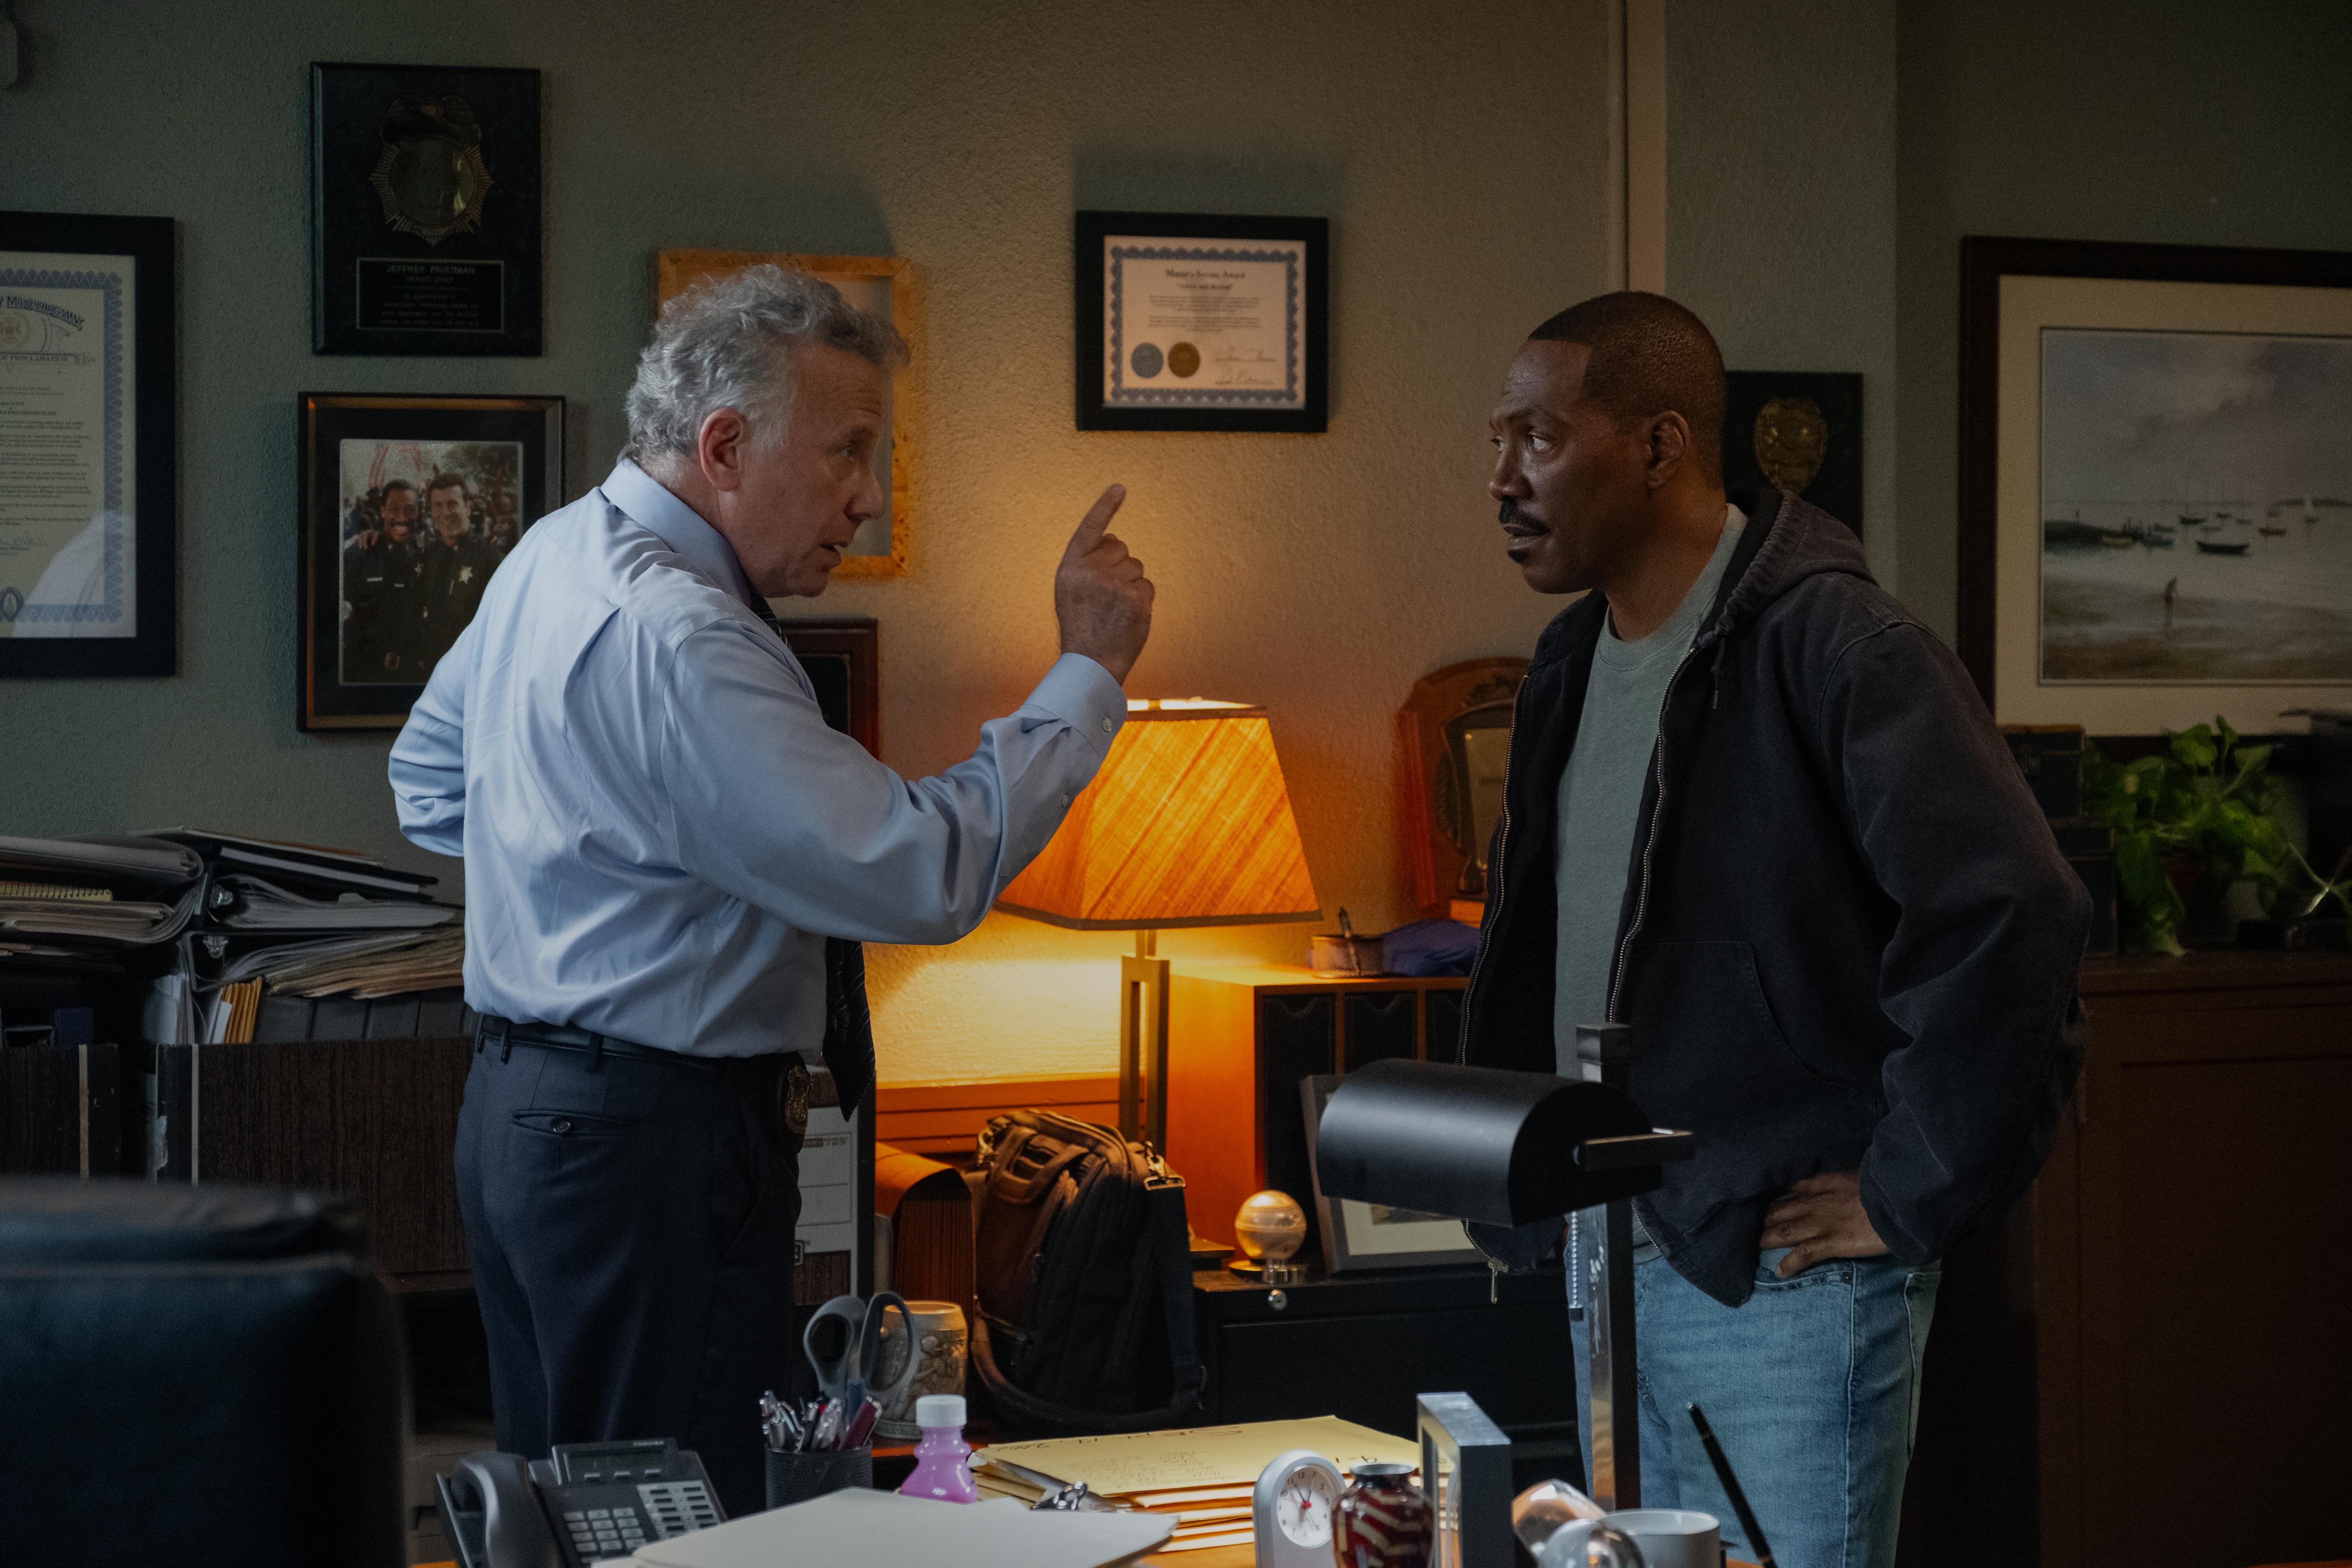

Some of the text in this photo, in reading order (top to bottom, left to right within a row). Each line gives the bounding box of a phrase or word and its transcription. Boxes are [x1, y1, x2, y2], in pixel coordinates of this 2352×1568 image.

[386, 264, 475, 274] JEFFREY FRIEDMAN
[824, 1138, 846, 1146] 725
